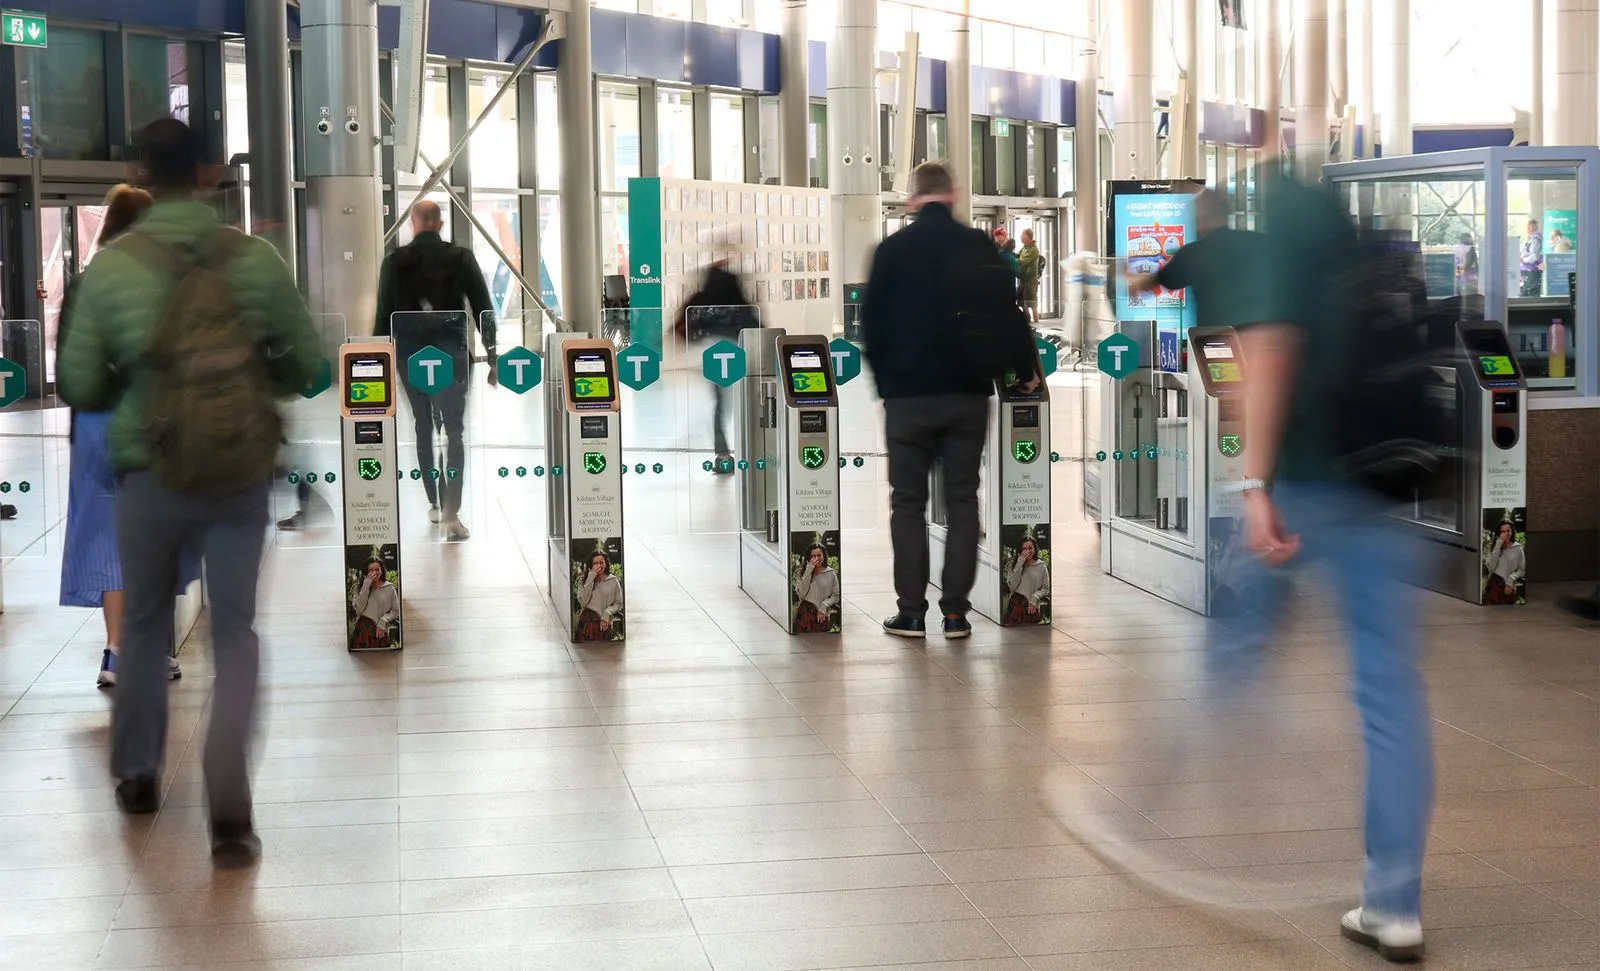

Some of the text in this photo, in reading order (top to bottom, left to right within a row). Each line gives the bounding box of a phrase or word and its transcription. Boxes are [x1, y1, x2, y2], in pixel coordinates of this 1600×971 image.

[626, 356, 649, 381] T
[713, 352, 735, 378] T
[831, 351, 850, 376] T
[1108, 346, 1128, 370] T
[419, 359, 442, 386] T
[508, 359, 531, 385] T
